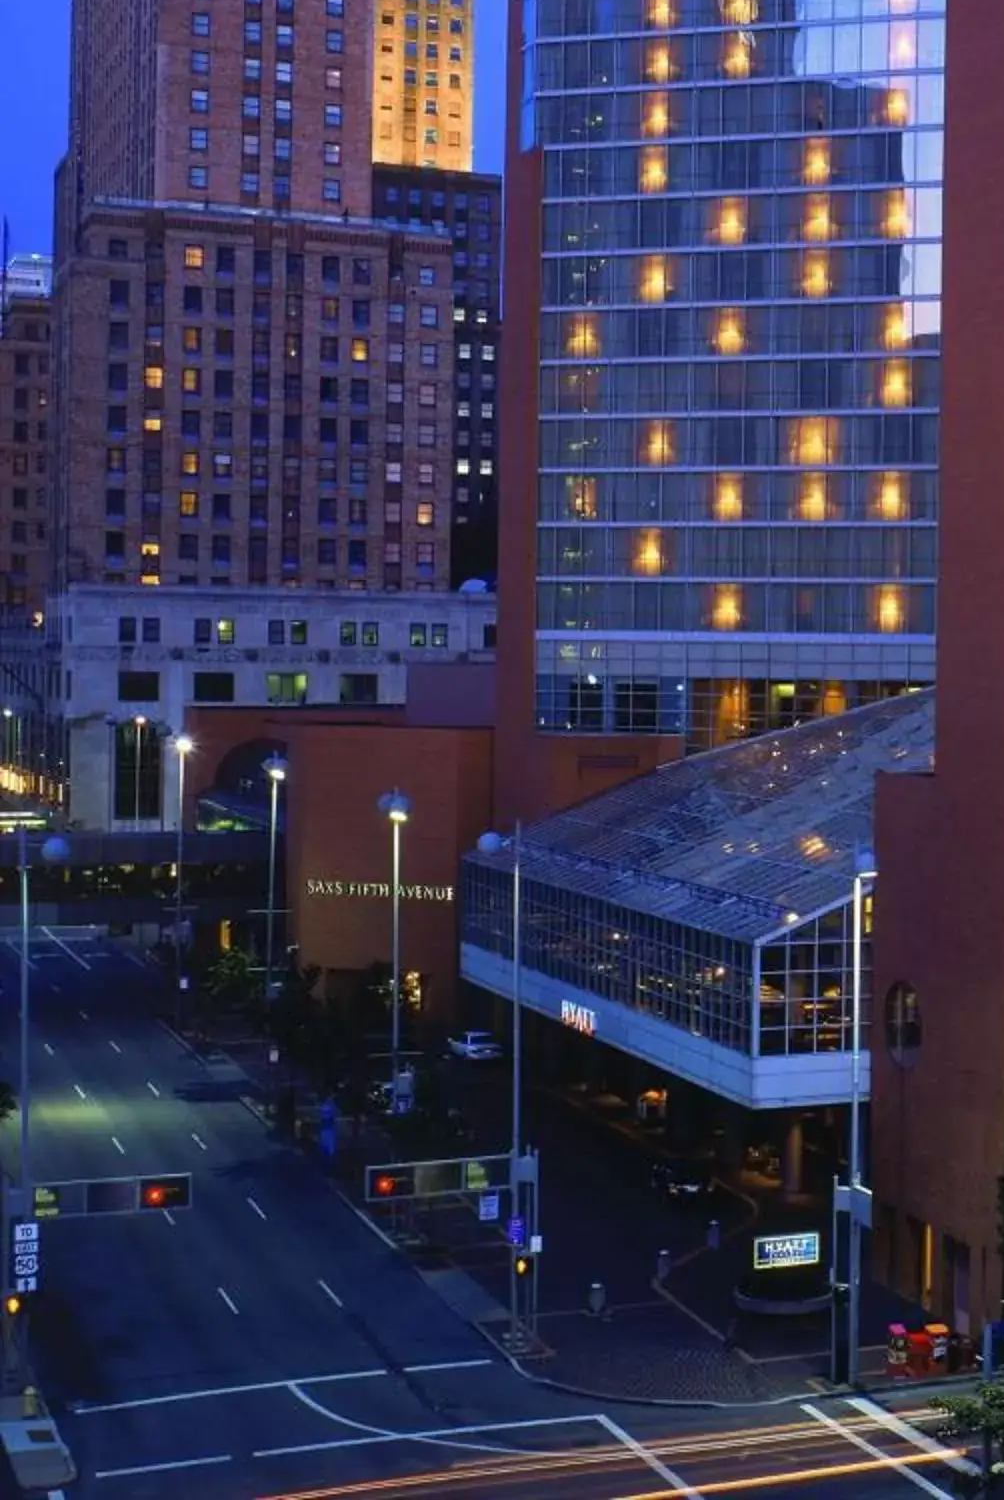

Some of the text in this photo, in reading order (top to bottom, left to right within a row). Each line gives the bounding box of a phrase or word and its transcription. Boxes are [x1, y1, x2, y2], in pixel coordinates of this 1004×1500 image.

[349, 883, 389, 897] FIFTH
[396, 884, 454, 901] AVENUE
[561, 999, 598, 1035] HYATT
